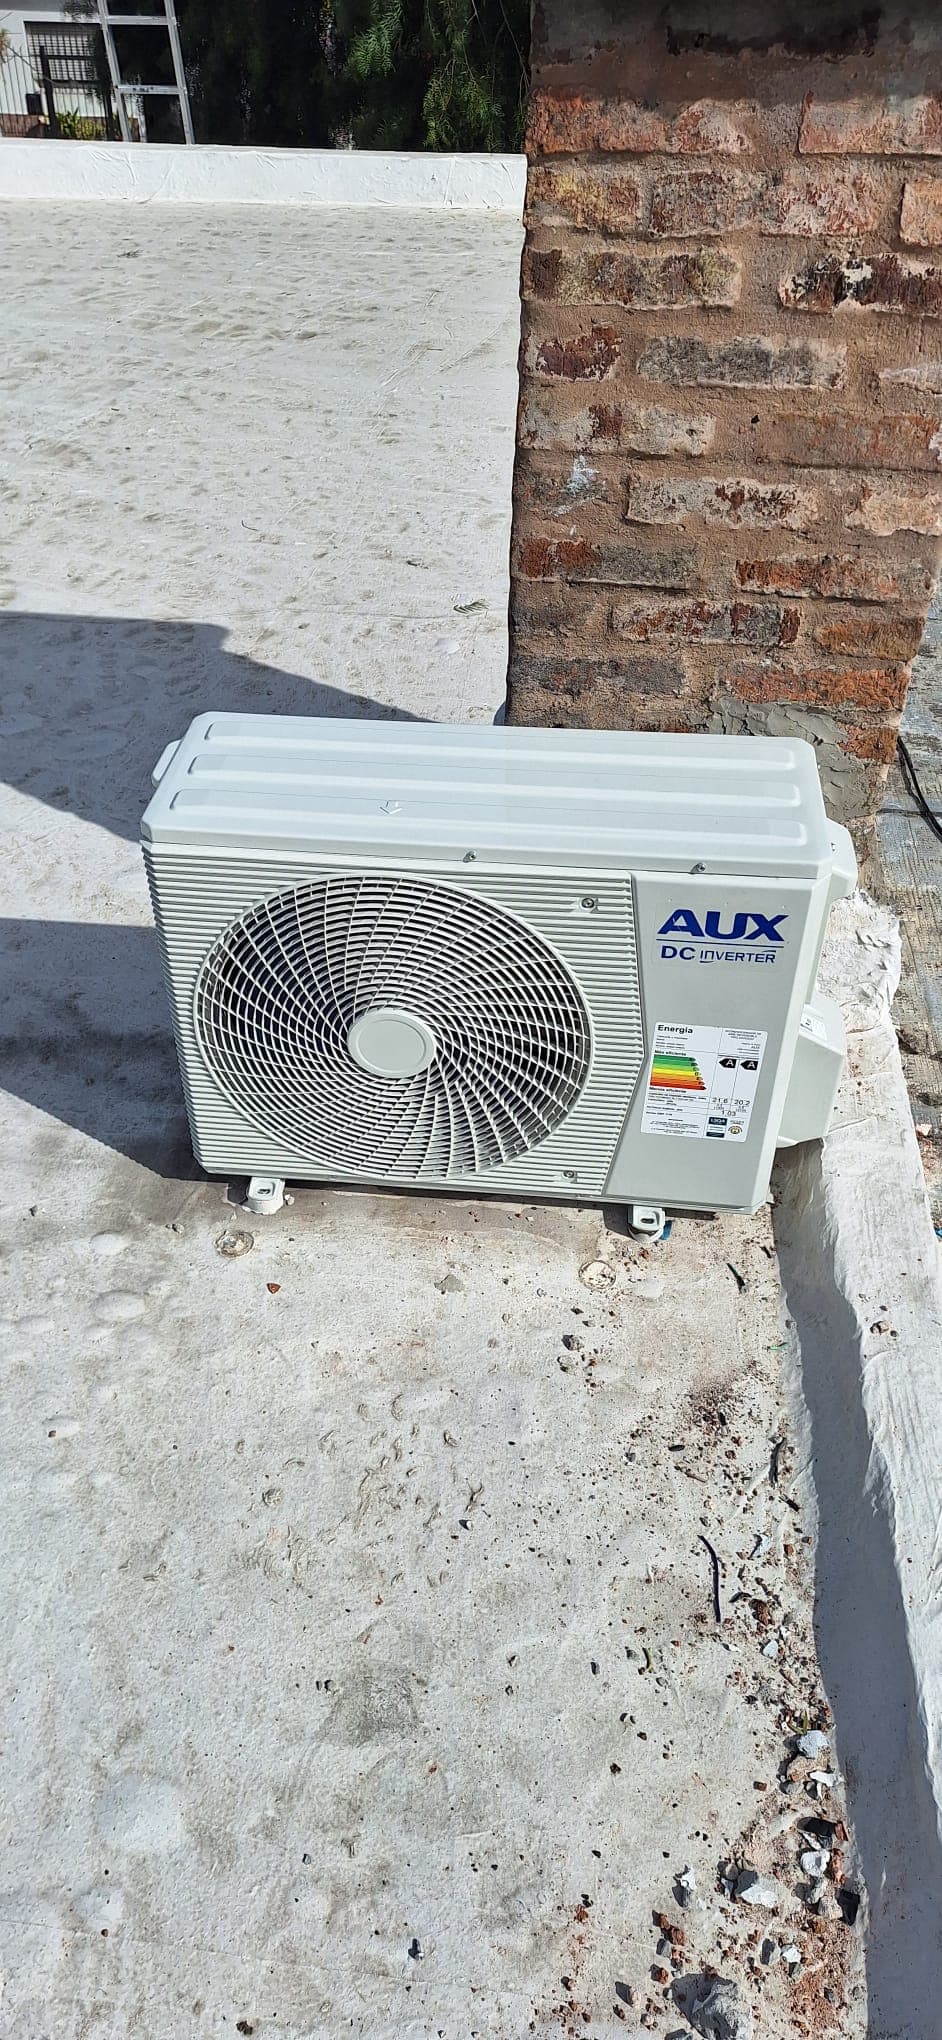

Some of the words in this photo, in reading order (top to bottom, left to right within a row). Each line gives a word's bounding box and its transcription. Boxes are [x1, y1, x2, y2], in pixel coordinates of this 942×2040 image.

[657, 909, 789, 941] AUX
[660, 945, 696, 960] DC
[747, 1061, 757, 1069] A
